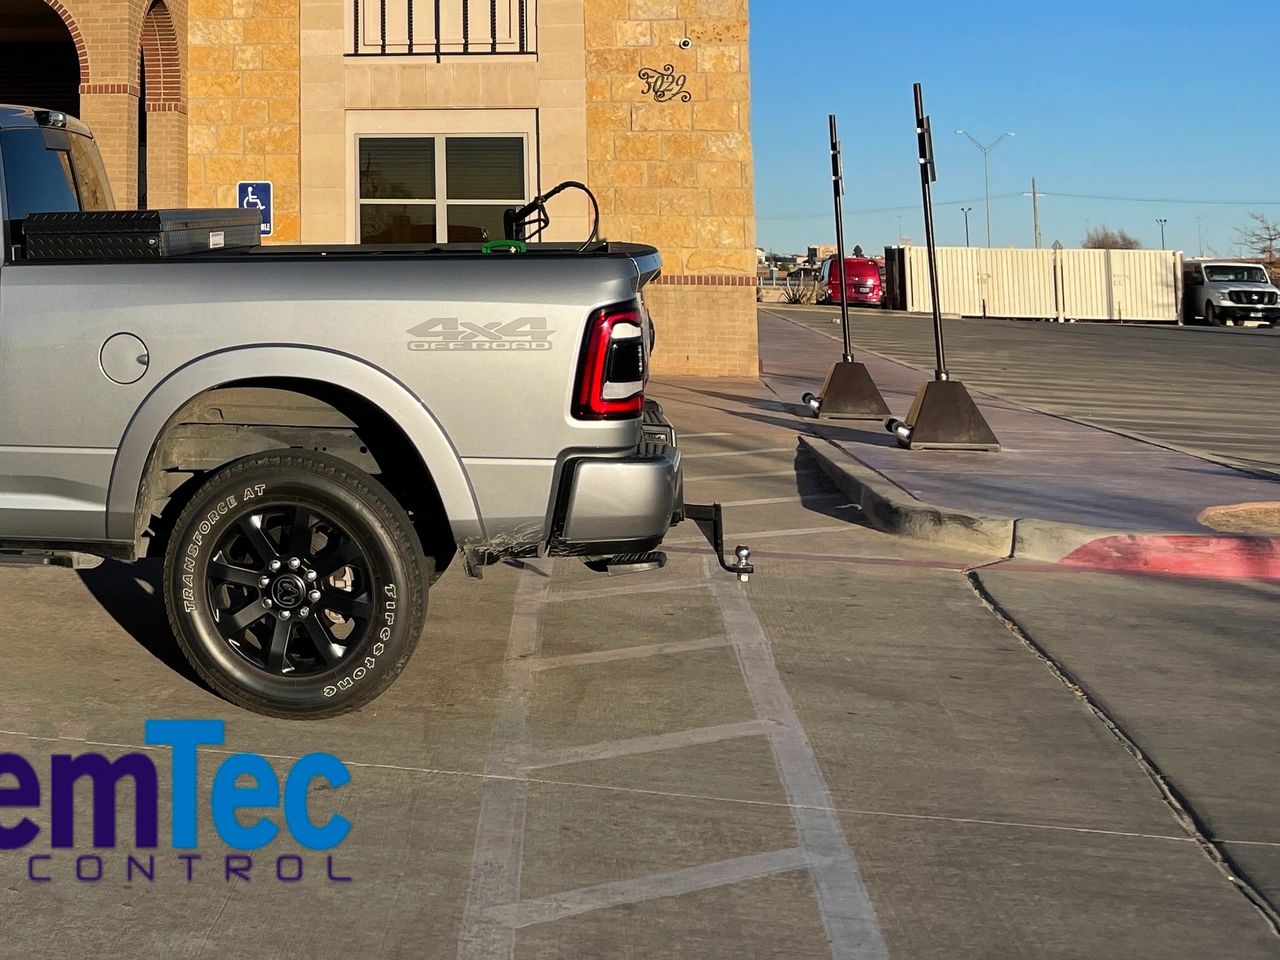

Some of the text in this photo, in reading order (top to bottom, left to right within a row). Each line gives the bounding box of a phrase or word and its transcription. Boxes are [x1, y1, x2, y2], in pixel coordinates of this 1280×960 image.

[410, 341, 550, 351] OFF ROAD
[178, 484, 266, 613] TRANSFORCE AT
